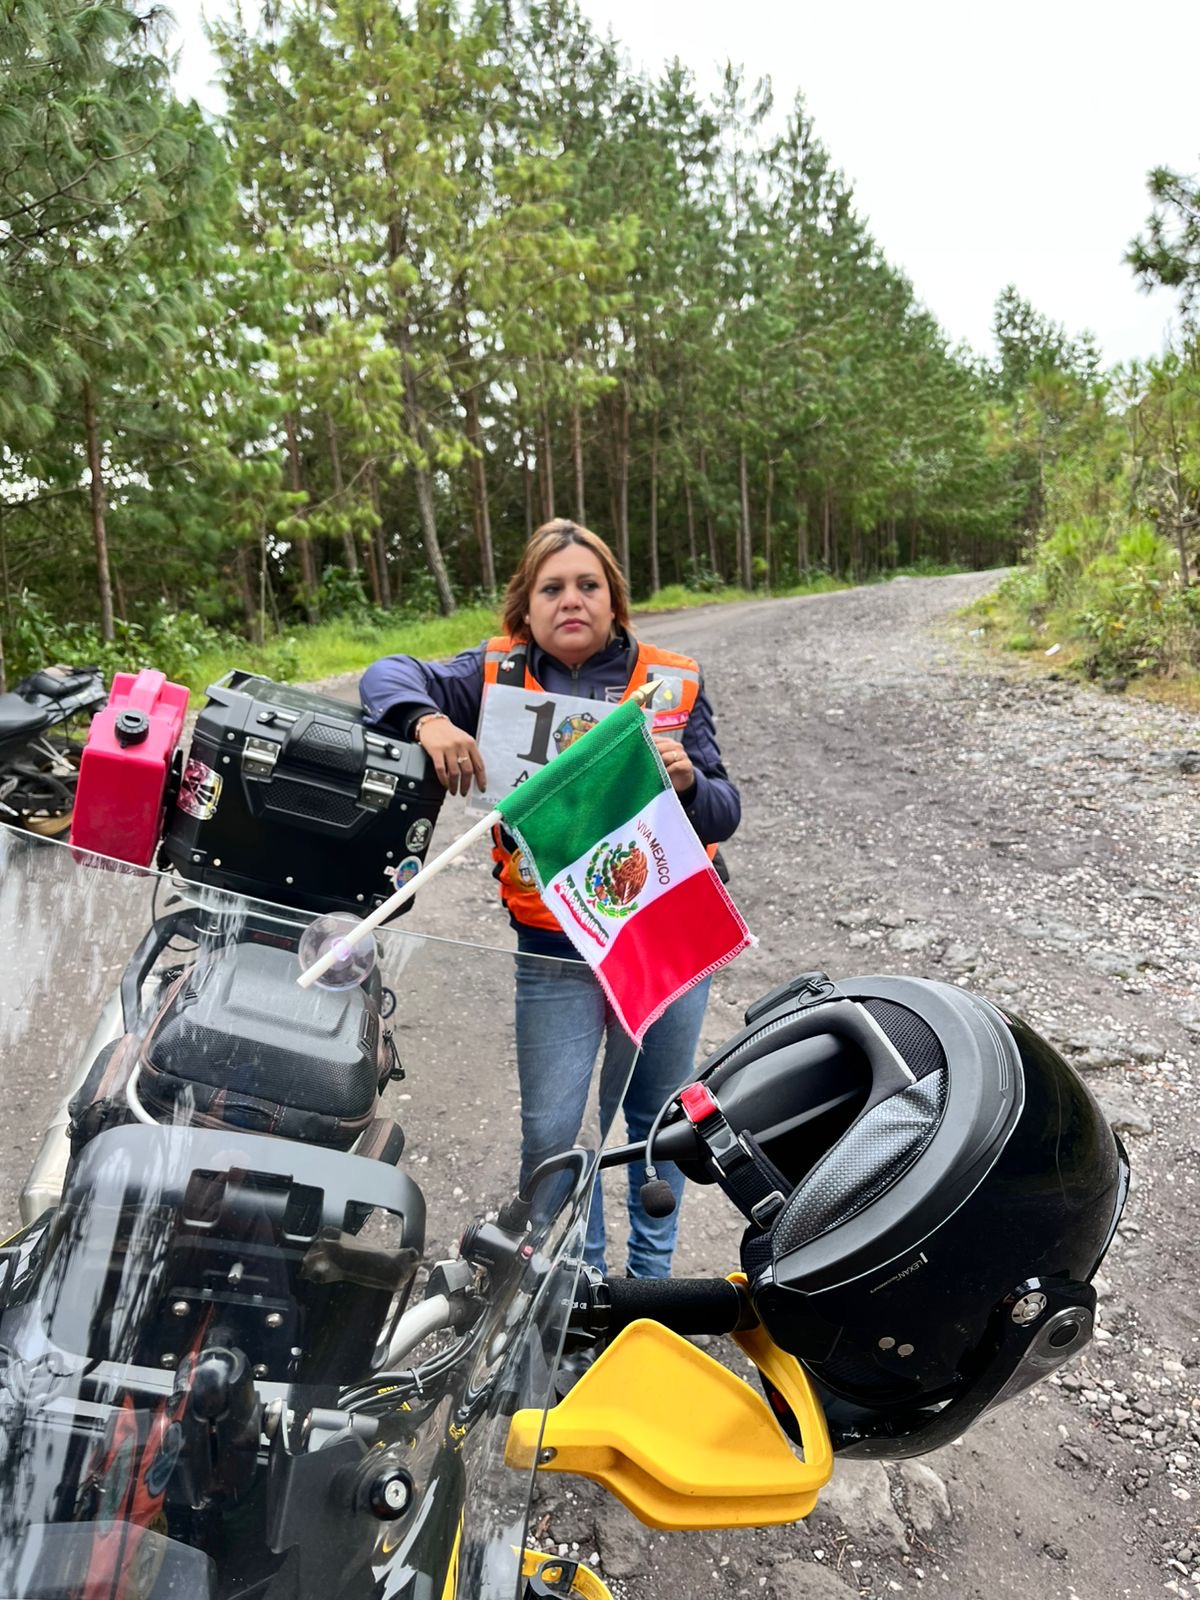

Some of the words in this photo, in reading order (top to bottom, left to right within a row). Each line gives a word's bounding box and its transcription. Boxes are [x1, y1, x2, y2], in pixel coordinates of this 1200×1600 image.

[637, 820, 652, 841] VIVA
[649, 838, 671, 886] MEXICO
[897, 1259, 924, 1280] LEXAN
